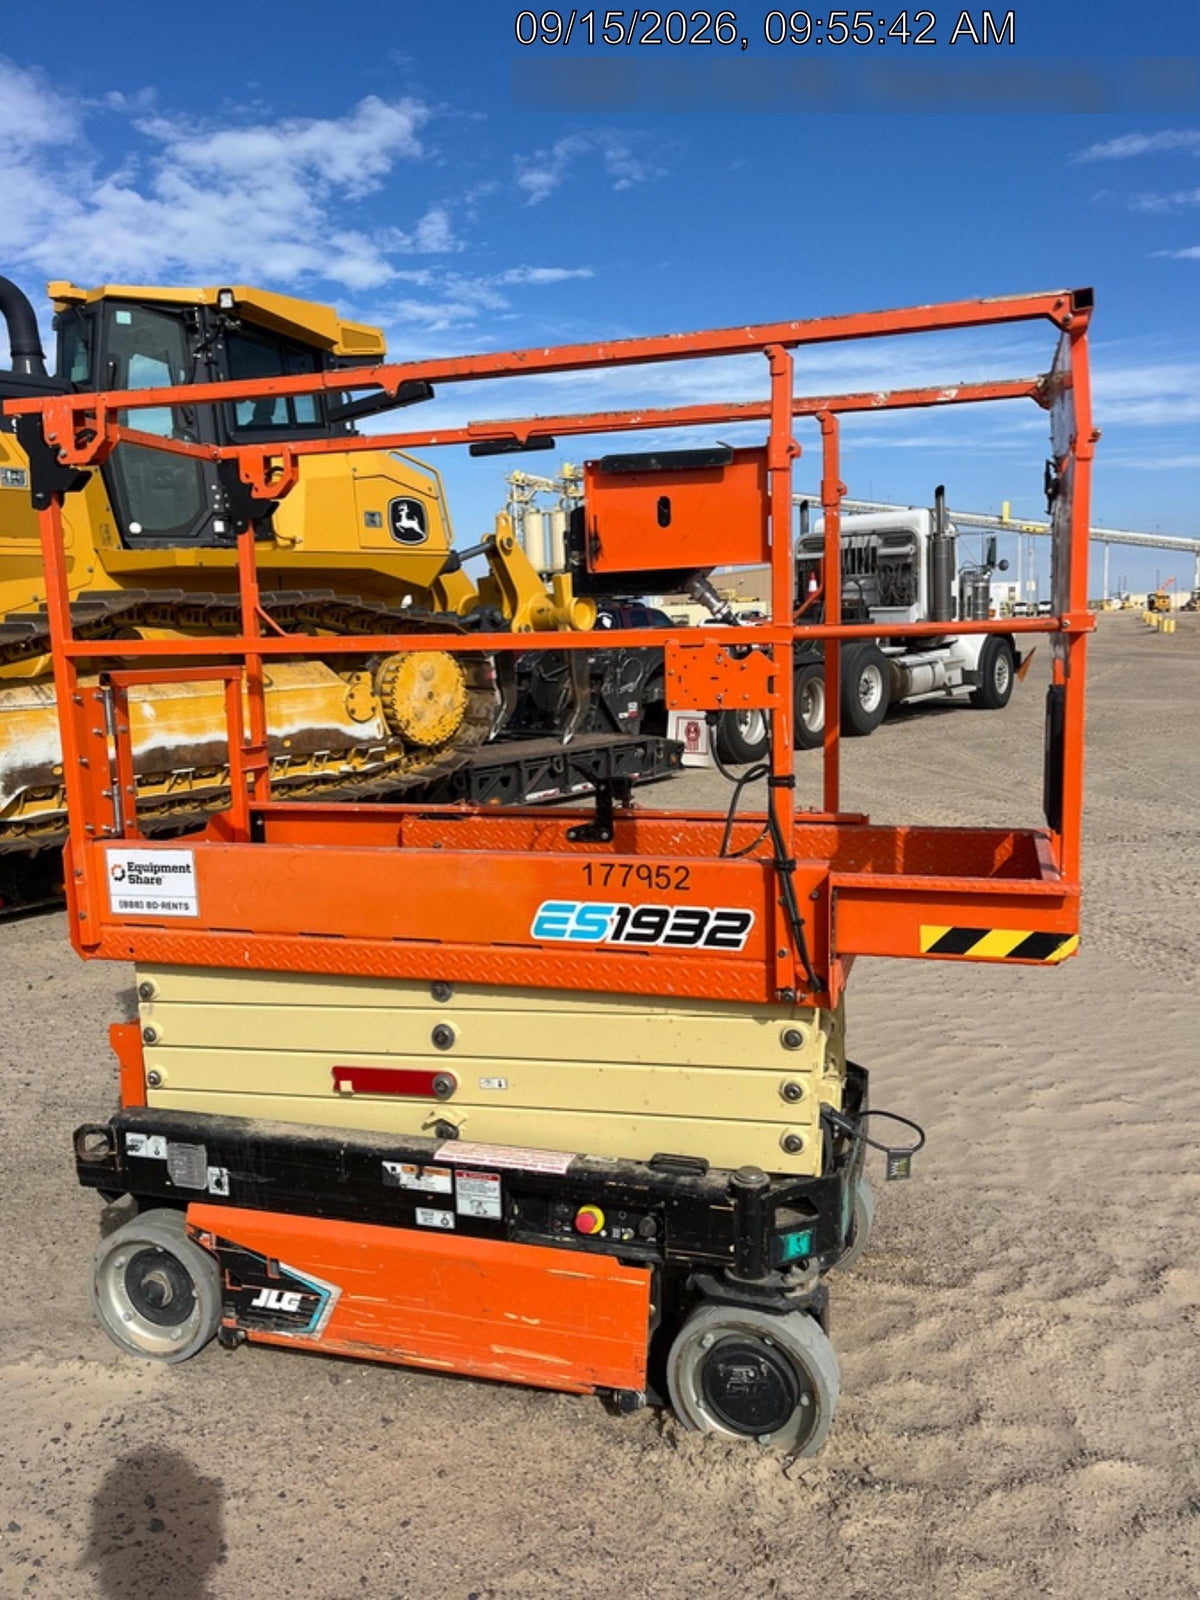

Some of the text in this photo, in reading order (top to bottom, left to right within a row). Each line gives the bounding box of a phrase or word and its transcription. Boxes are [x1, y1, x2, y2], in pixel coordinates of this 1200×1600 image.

[127, 862, 191, 875] Equipment
[582, 862, 691, 891] 177952
[128, 874, 162, 886] Share
[119, 900, 144, 909] (888)
[532, 901, 753, 949] ES1932
[251, 1289, 302, 1312] JLG
